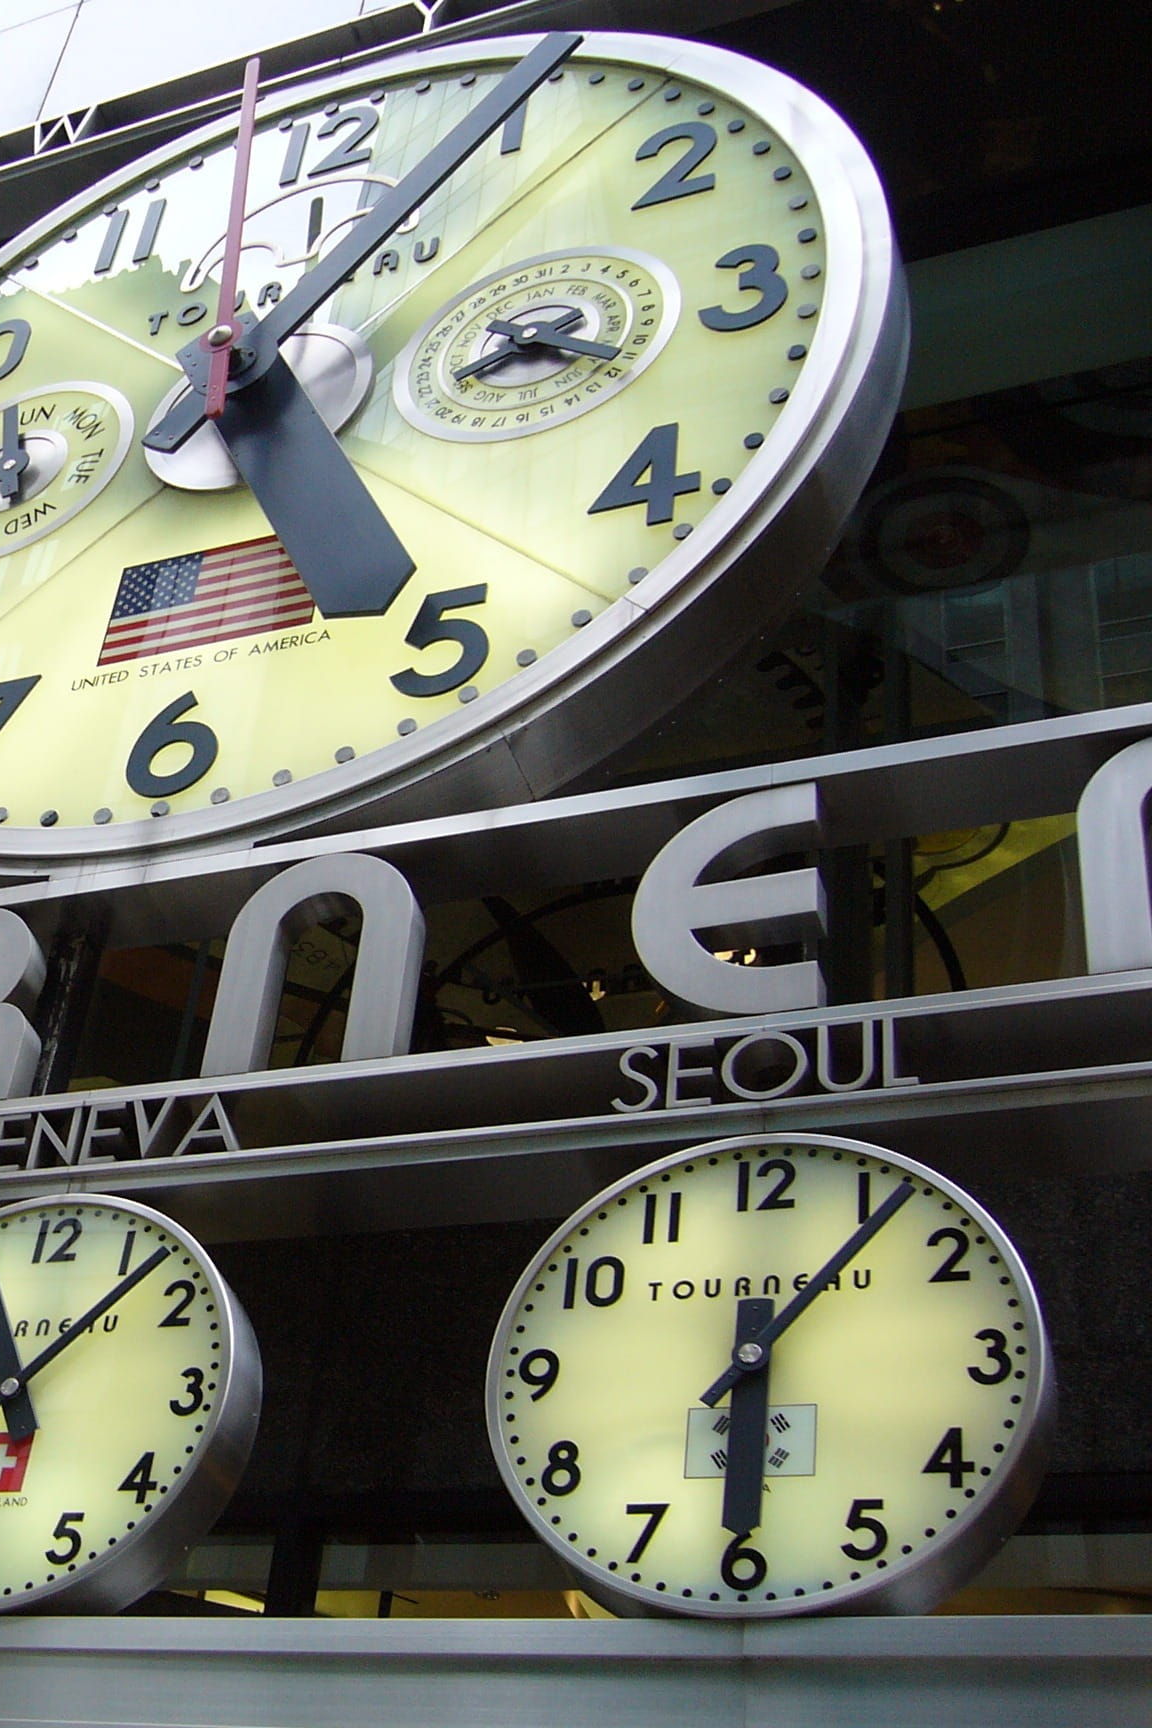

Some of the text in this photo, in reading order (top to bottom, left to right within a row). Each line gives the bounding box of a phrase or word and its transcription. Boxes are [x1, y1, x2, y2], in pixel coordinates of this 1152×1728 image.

[279, 106, 379, 186] 12
[631, 121, 718, 211] 2
[94, 199, 166, 274] 11
[512, 274, 529, 287] 30
[561, 264, 570, 274] 2
[600, 264, 612, 275] 4
[616, 269, 629, 279] 5
[629, 278, 640, 288] 6
[148, 237, 440, 335] TORAU
[488, 284, 506, 297] 29
[527, 286, 556, 302] JAN
[567, 284, 589, 296] FEB
[637, 289, 652, 297] 7
[698, 243, 788, 332] 3
[485, 300, 514, 321] DEC
[592, 292, 617, 312] MAR
[642, 303, 656, 312] 8
[457, 322, 482, 348] NOV
[606, 314, 622, 334] APR
[640, 318, 654, 327] 9
[425, 341, 441, 354] 25
[632, 334, 649, 345] 10
[622, 351, 637, 360] 11
[554, 367, 583, 388] JUN
[585, 381, 602, 393] 13
[604, 366, 622, 379] 12
[473, 390, 506, 403] AUG
[519, 387, 538, 400] JUL
[564, 393, 581, 406] 14
[19, 404, 57, 426] UN
[64, 406, 106, 441] MON
[435, 406, 453, 419] 20
[451, 413, 467, 425] 19
[471, 416, 486, 427] 18
[490, 416, 507, 428] 17
[515, 411, 530, 423] 16
[539, 404, 555, 417] 15
[67, 447, 105, 484] TUE
[587, 422, 701, 526] 4
[4, 501, 57, 535] WED
[389, 583, 489, 698] 5
[71, 629, 331, 692] UNITED STATES OF AMERICA
[125, 691, 219, 798] 6
[611, 1018, 920, 1112] SEOUL
[737, 1159, 796, 1212] 12
[858, 1172, 871, 1224] 1
[643, 1192, 682, 1244] 11
[32, 1218, 83, 1264] 12
[118, 1230, 136, 1275] 1
[927, 1227, 971, 1283] 2
[563, 1255, 625, 1310] 10
[157, 1280, 196, 1327] 2
[967, 1329, 1012, 1386] 3
[518, 1348, 560, 1402] 9
[169, 1368, 204, 1416] 3
[541, 1440, 581, 1497] 8
[921, 1427, 975, 1488] 4
[118, 1452, 158, 1504] 4
[45, 1512, 85, 1565] 5
[626, 1503, 670, 1564] 7
[841, 1499, 888, 1561] 5
[720, 1531, 767, 1592] 6
